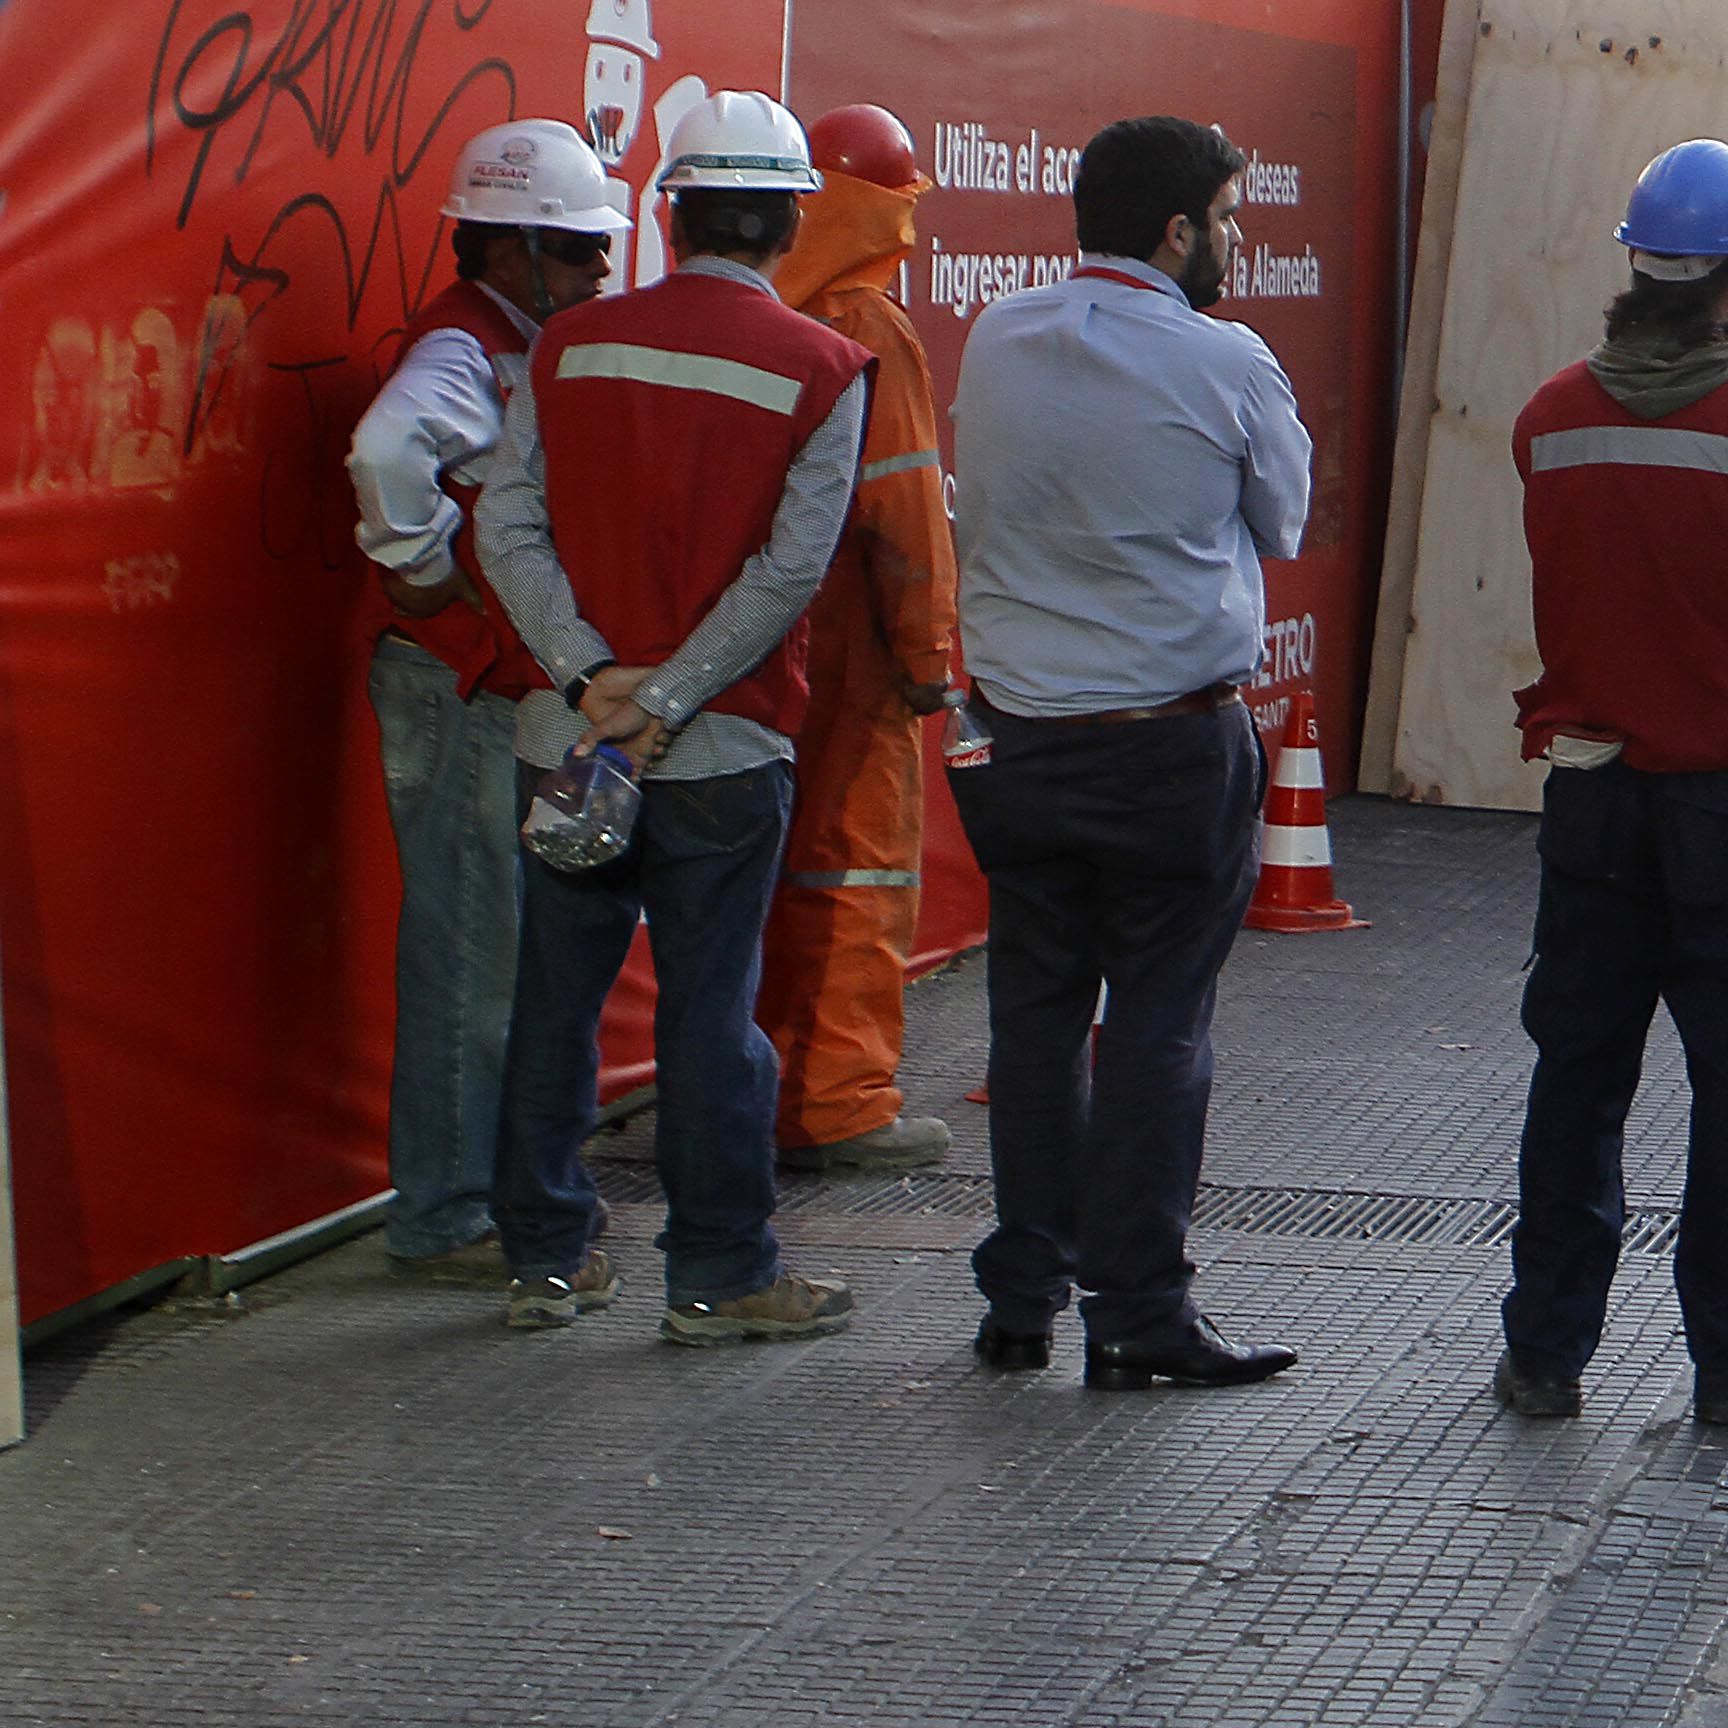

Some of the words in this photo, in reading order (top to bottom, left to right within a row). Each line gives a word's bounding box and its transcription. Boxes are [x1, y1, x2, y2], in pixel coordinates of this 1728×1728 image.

[934, 122, 1009, 190] Utiliza
[1016, 128, 1036, 193] el
[1247, 148, 1299, 205] deseas
[931, 236, 1028, 318] ingresar
[1233, 246, 1247, 297] la
[1251, 243, 1319, 296] Alameda
[1307, 719, 1319, 741] 5
